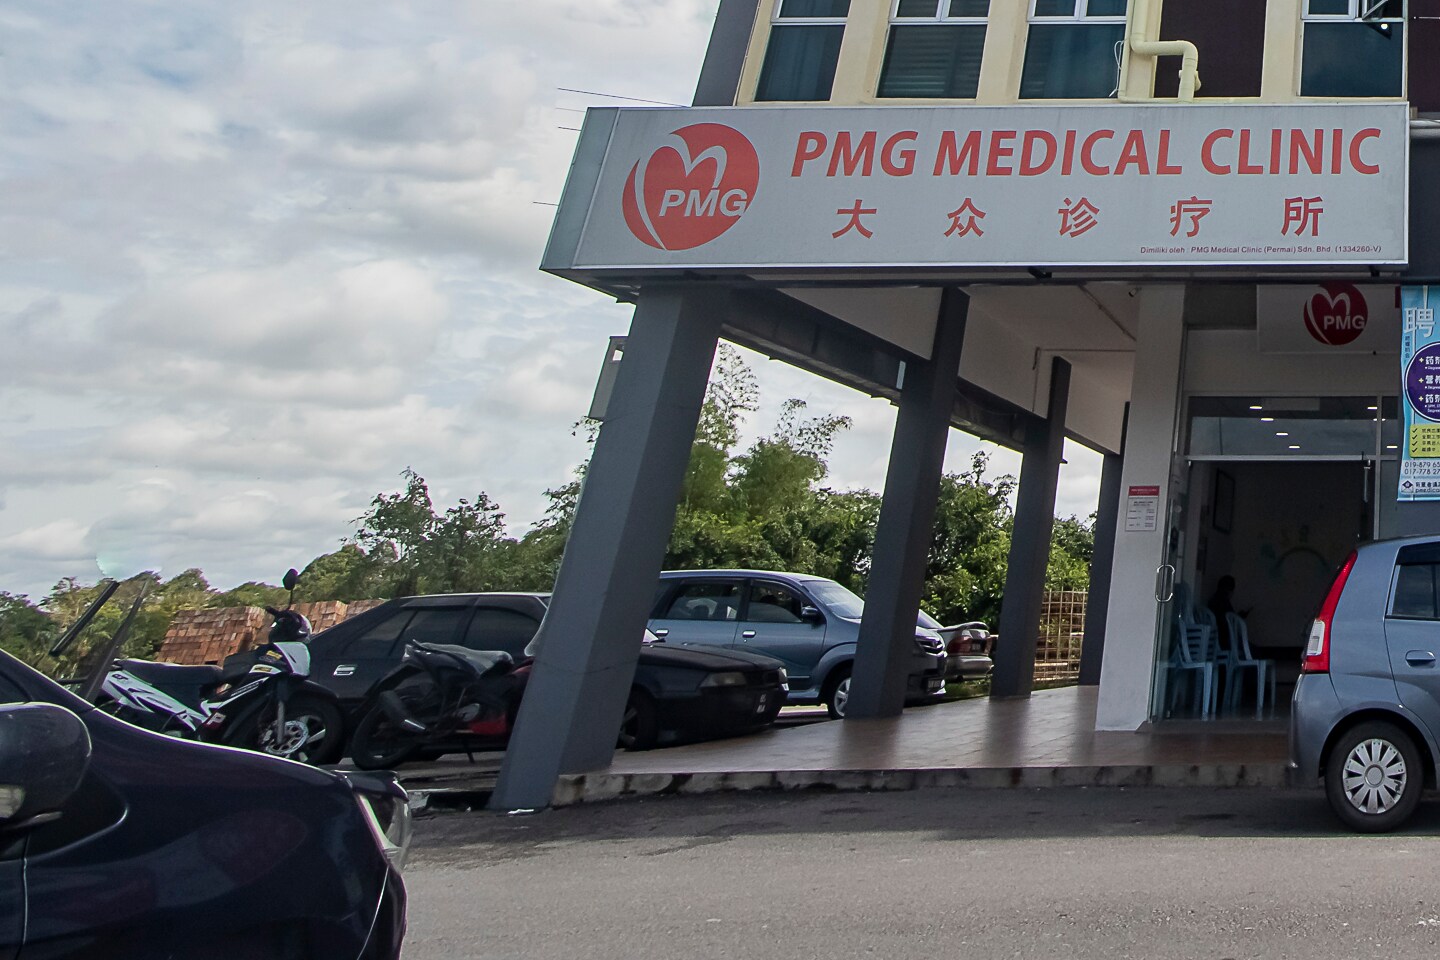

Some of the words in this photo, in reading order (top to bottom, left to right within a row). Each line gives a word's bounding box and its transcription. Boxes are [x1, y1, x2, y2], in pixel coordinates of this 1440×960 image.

[790, 129, 920, 178] PMG
[932, 128, 1183, 177] MEDICAL
[1200, 127, 1382, 176] CLINIC
[659, 189, 749, 217] PMG
[831, 196, 1324, 240] 大众诊疗所
[1140, 246, 1168, 254] Dimiliki
[1168, 246, 1185, 254] oleh
[1190, 246, 1209, 254] PMG
[1210, 246, 1240, 254] Medical
[1241, 246, 1262, 254] Clinic
[1263, 246, 1297, 254] (Permai)
[1323, 314, 1366, 331] PMG
